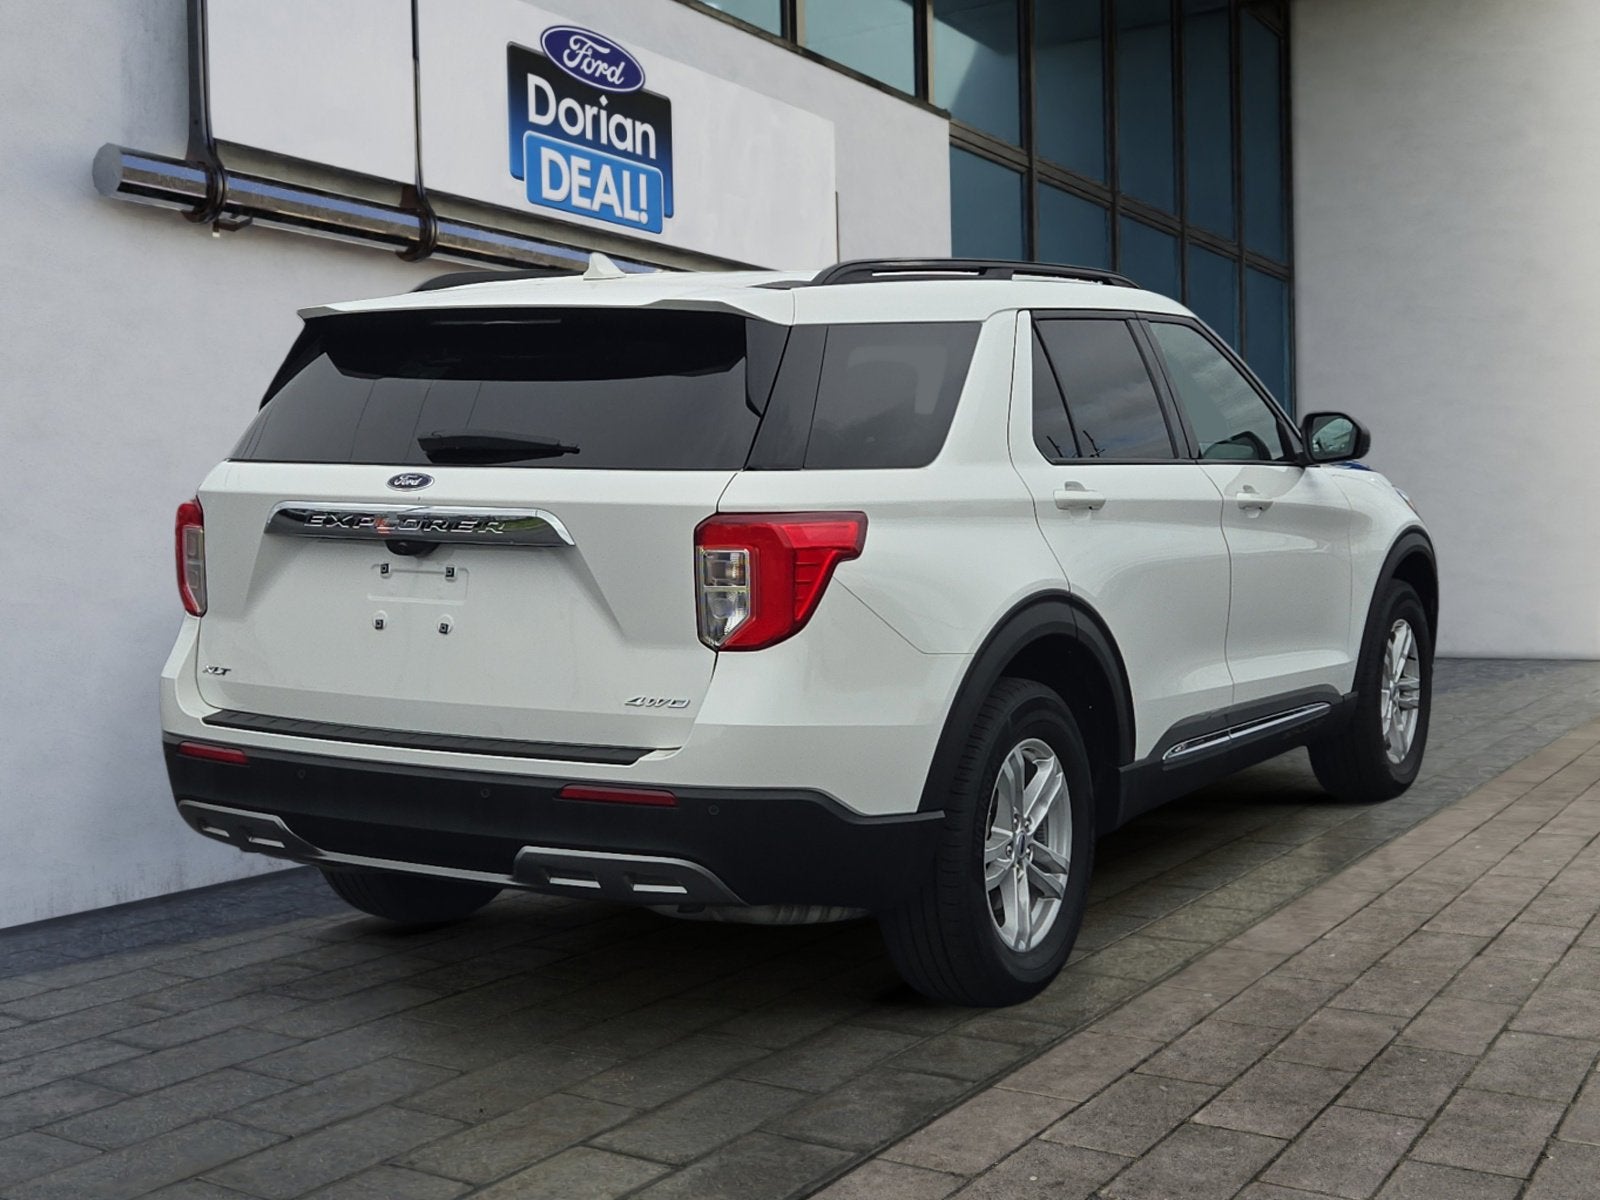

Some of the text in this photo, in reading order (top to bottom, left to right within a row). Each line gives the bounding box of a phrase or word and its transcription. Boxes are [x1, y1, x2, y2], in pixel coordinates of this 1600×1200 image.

[563, 35, 625, 85] Ford
[527, 72, 656, 160] Dorian
[541, 146, 649, 225] DEAL!
[304, 513, 505, 535] EXPLORER
[623, 696, 691, 709] 4WD
